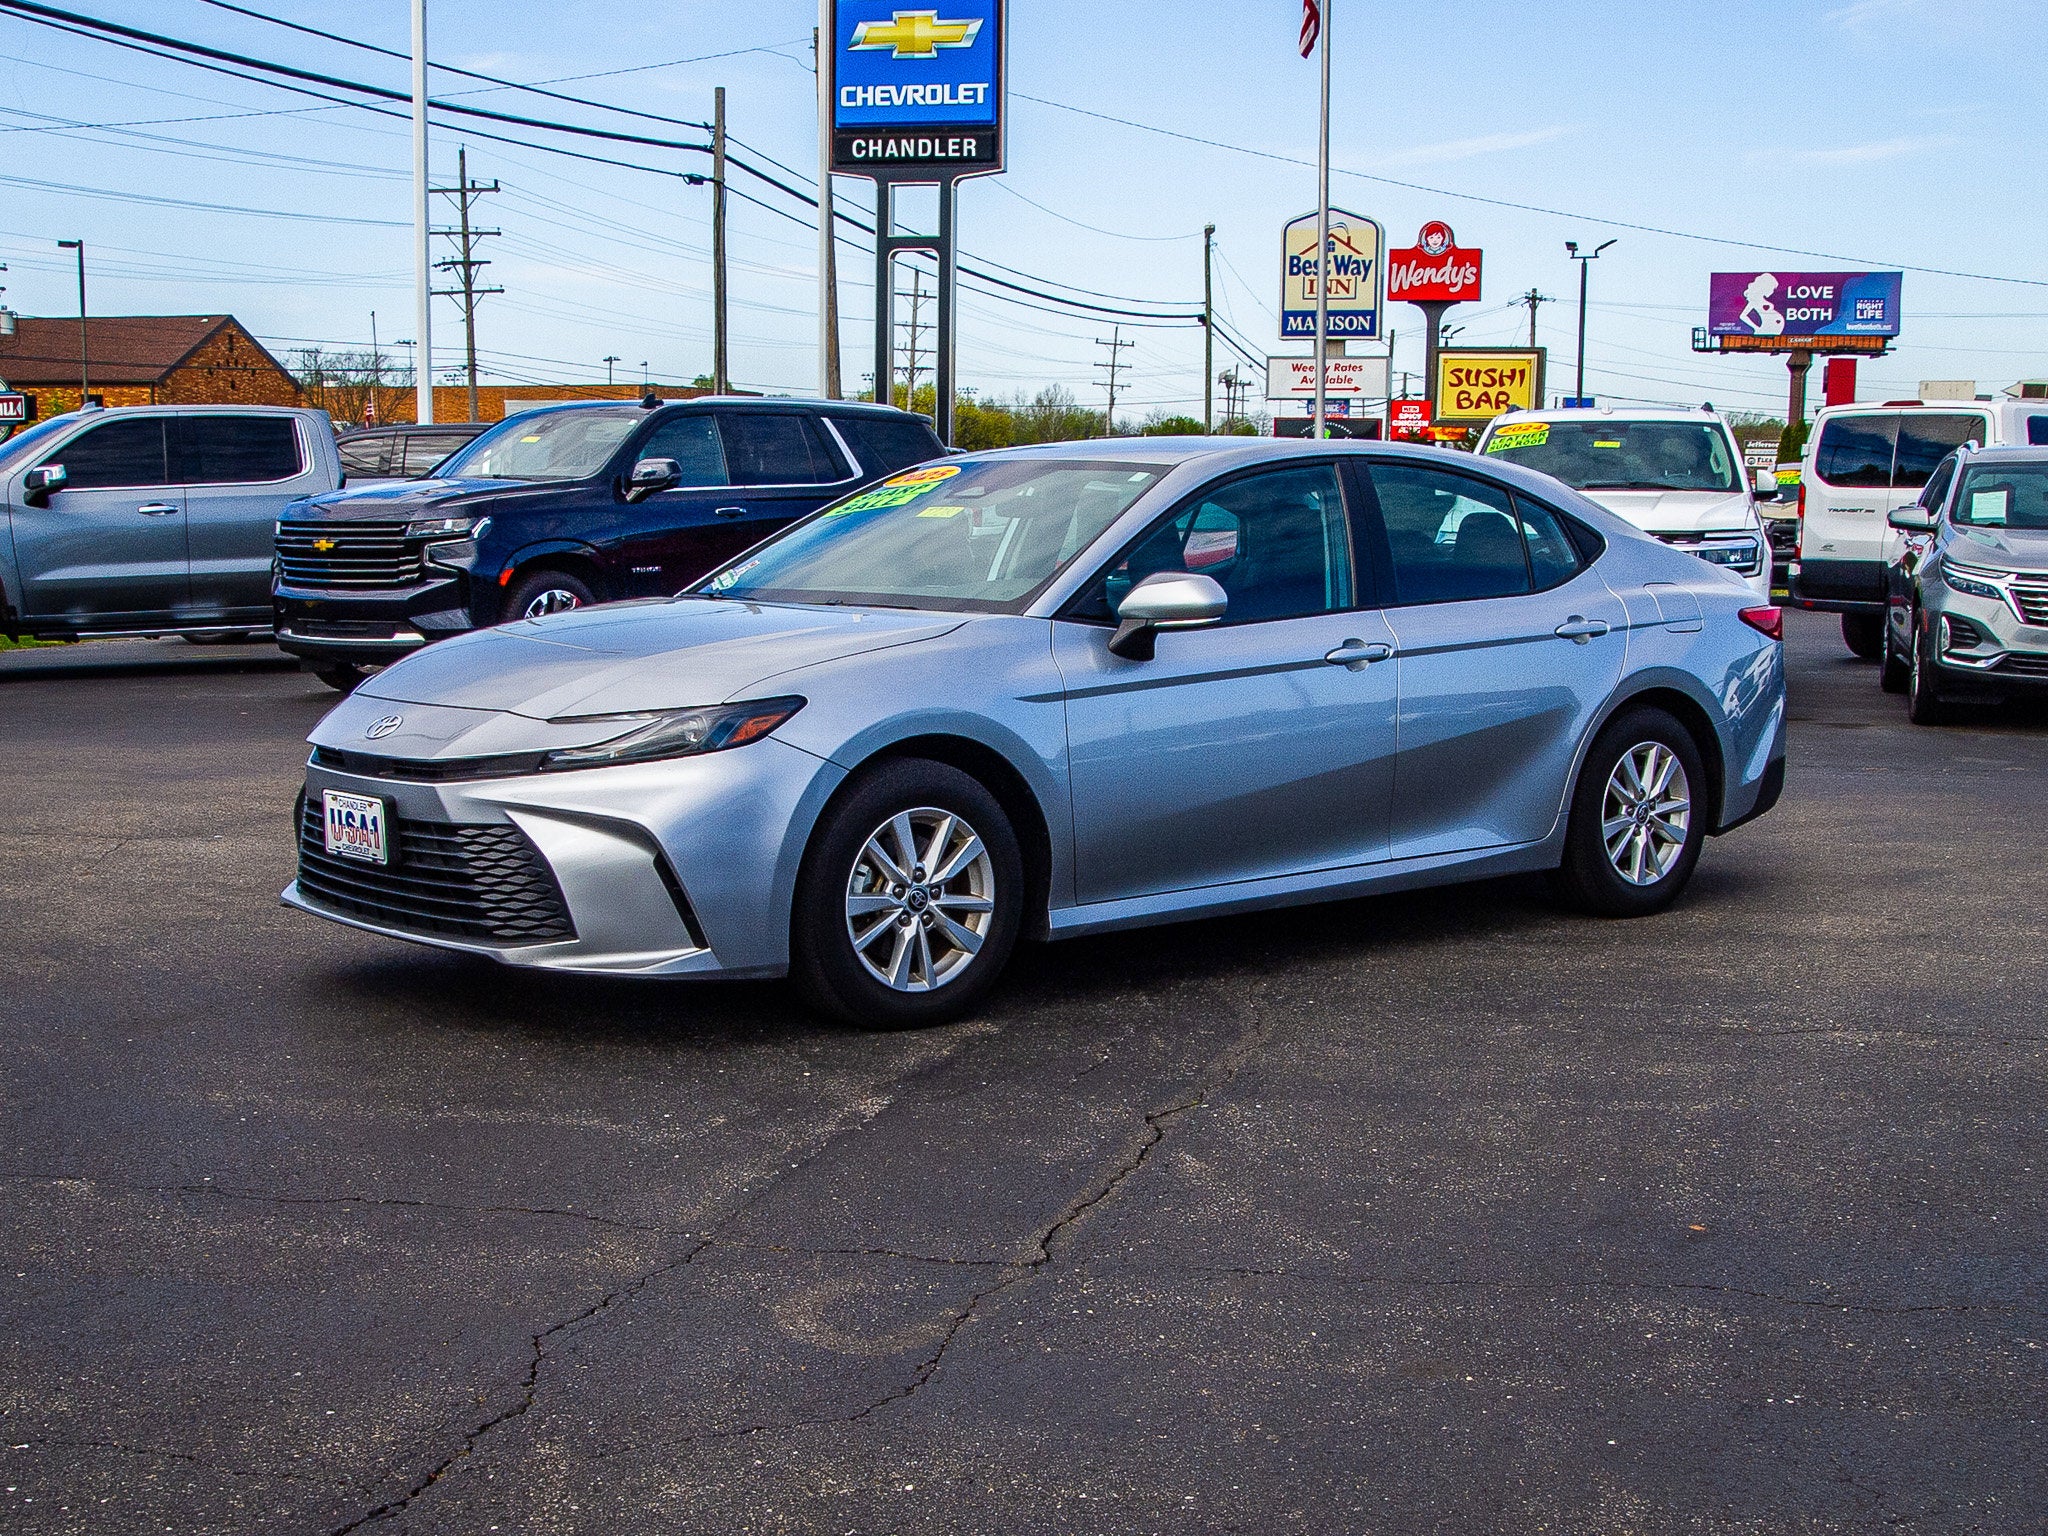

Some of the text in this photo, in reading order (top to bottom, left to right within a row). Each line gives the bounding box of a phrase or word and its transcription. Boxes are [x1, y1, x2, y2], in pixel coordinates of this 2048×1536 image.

[840, 83, 989, 107] CHEVROLET
[852, 138, 977, 158] CHANDLER
[1333, 255, 1373, 282] Way
[1390, 256, 1477, 294] Wendy's
[1787, 285, 1834, 299] LOVE
[1856, 303, 1884, 311] RIGHT
[1786, 308, 1833, 321] BOTH
[1856, 310, 1884, 319] LIFE
[1286, 316, 1372, 331] MAISON
[1291, 363, 1363, 374] Weey Rates
[1300, 375, 1353, 385] Avlable
[1448, 368, 1526, 388] SUSHI
[1456, 390, 1511, 410] BAR
[1500, 424, 1544, 434] 2024
[1489, 438, 1544, 451] SUN ROOF
[1492, 432, 1547, 445] LEATHER
